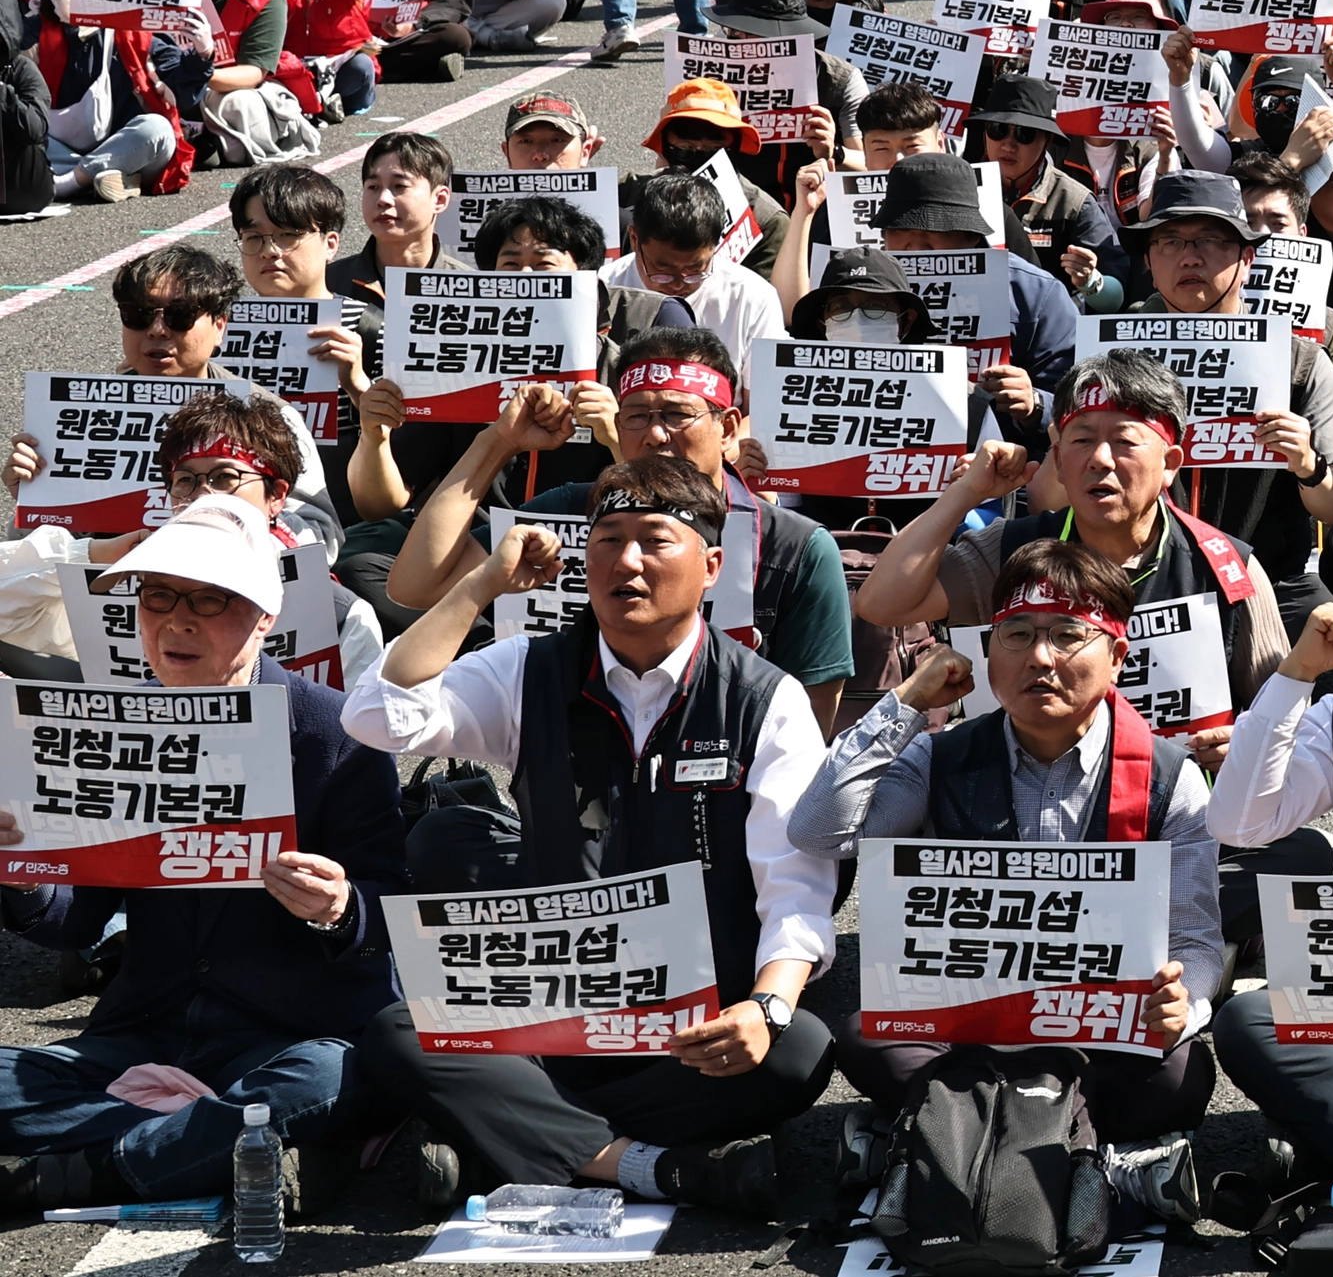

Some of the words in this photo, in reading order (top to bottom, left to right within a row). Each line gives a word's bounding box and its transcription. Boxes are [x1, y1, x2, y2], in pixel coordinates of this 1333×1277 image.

[619, 364, 647, 395] 단결
[674, 365, 719, 398] 투쟁
[39, 691, 117, 719] 열사의
[122, 695, 234, 723] 염원이다!
[694, 740, 729, 753] 민주노총
[28, 778, 245, 825] 노동기본권
[27, 862, 69, 874] 민주노총
[918, 850, 999, 879] 열사의
[1005, 851, 1122, 880] 염원이다!
[442, 897, 529, 925] 열사의
[537, 880, 656, 921] 염원이다!
[898, 940, 1124, 985] 노동기본권
[445, 964, 668, 1009] 노동기본권
[892, 1020, 936, 1033] 민주노총
